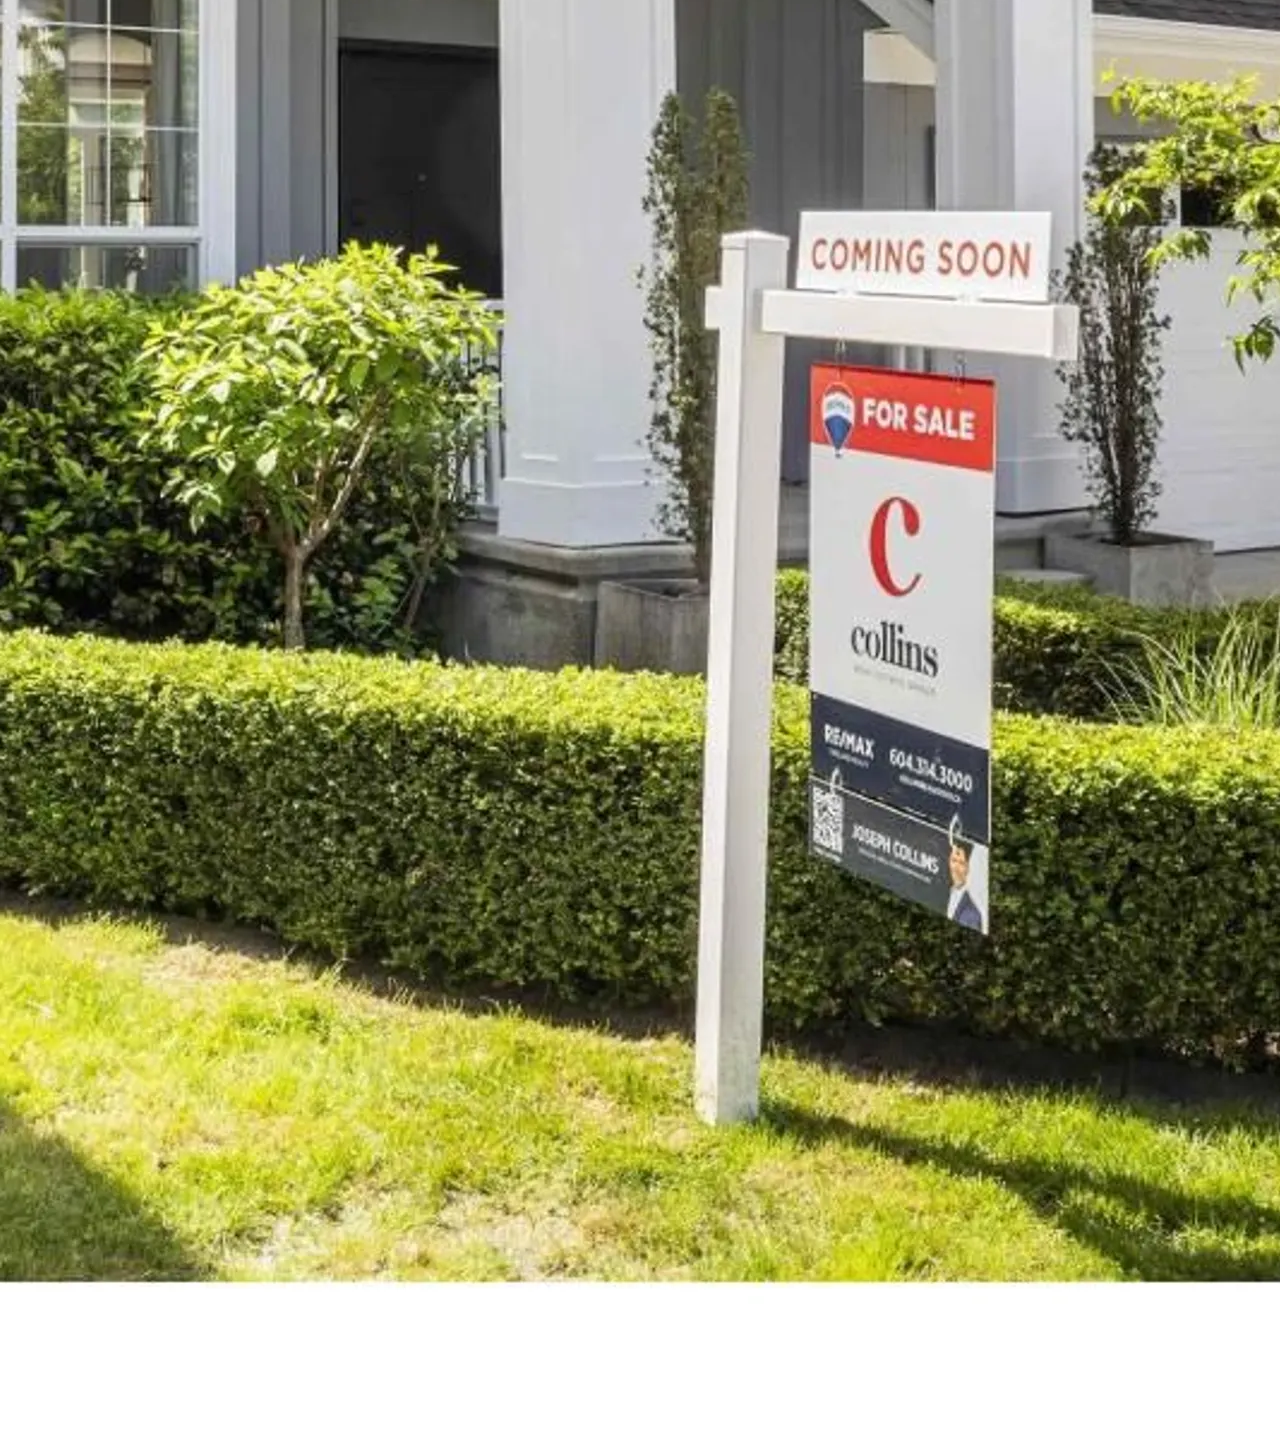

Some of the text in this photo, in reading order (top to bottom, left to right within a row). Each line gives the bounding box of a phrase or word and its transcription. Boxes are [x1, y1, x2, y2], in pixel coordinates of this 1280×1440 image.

[812, 238, 1031, 278] COMING SOON
[862, 398, 908, 431] FOR
[913, 404, 975, 441] SALE
[851, 620, 939, 678] collins
[824, 723, 875, 761] RE/MAX
[851, 823, 891, 854] JOSEPH
[892, 840, 939, 874] COLLINS
